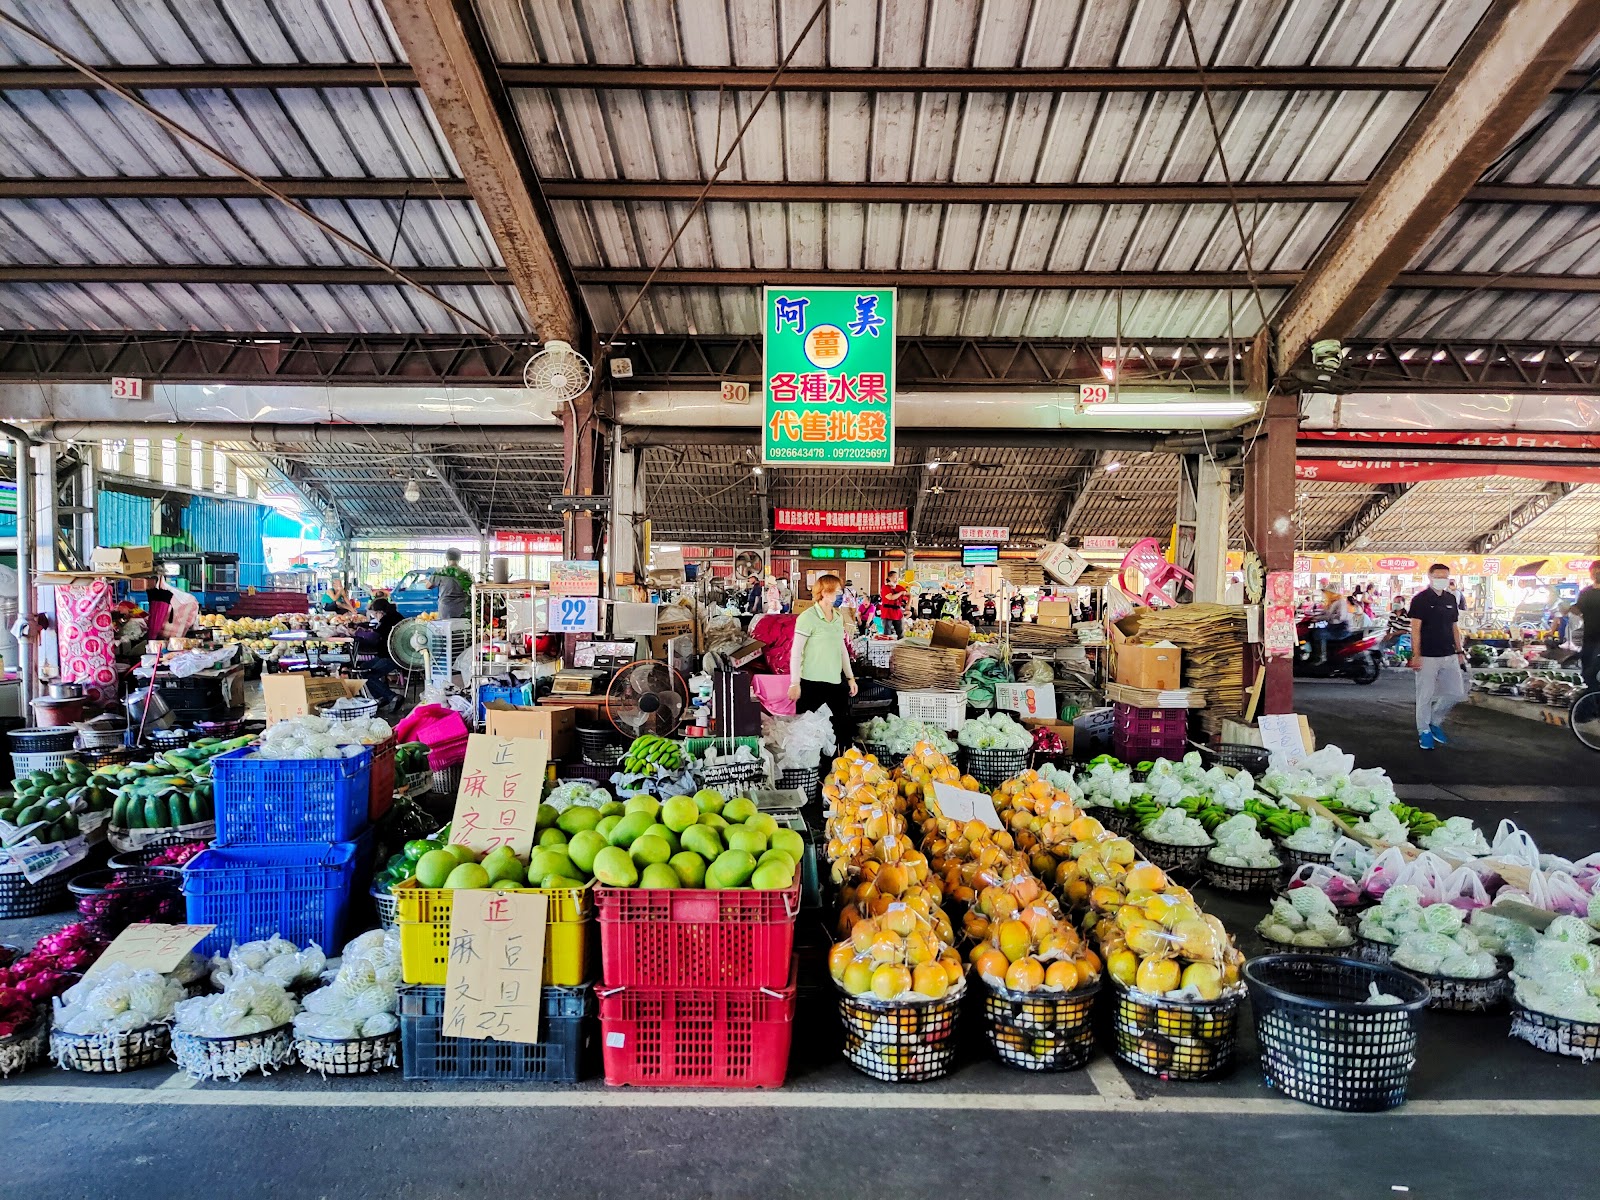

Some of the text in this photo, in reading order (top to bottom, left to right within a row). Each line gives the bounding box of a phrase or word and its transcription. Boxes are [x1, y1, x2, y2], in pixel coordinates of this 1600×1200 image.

[776, 296, 886, 337] 阿 美
[114, 379, 139, 397] 31
[723, 384, 747, 401] 30
[770, 373, 886, 403] 各種水果
[1083, 387, 1107, 402] 29
[770, 411, 886, 441] 代售批發
[769, 447, 887, 458] 0926643478 0972025697
[561, 599, 586, 626] 22
[492, 742, 515, 765] 正
[484, 898, 514, 922] 正
